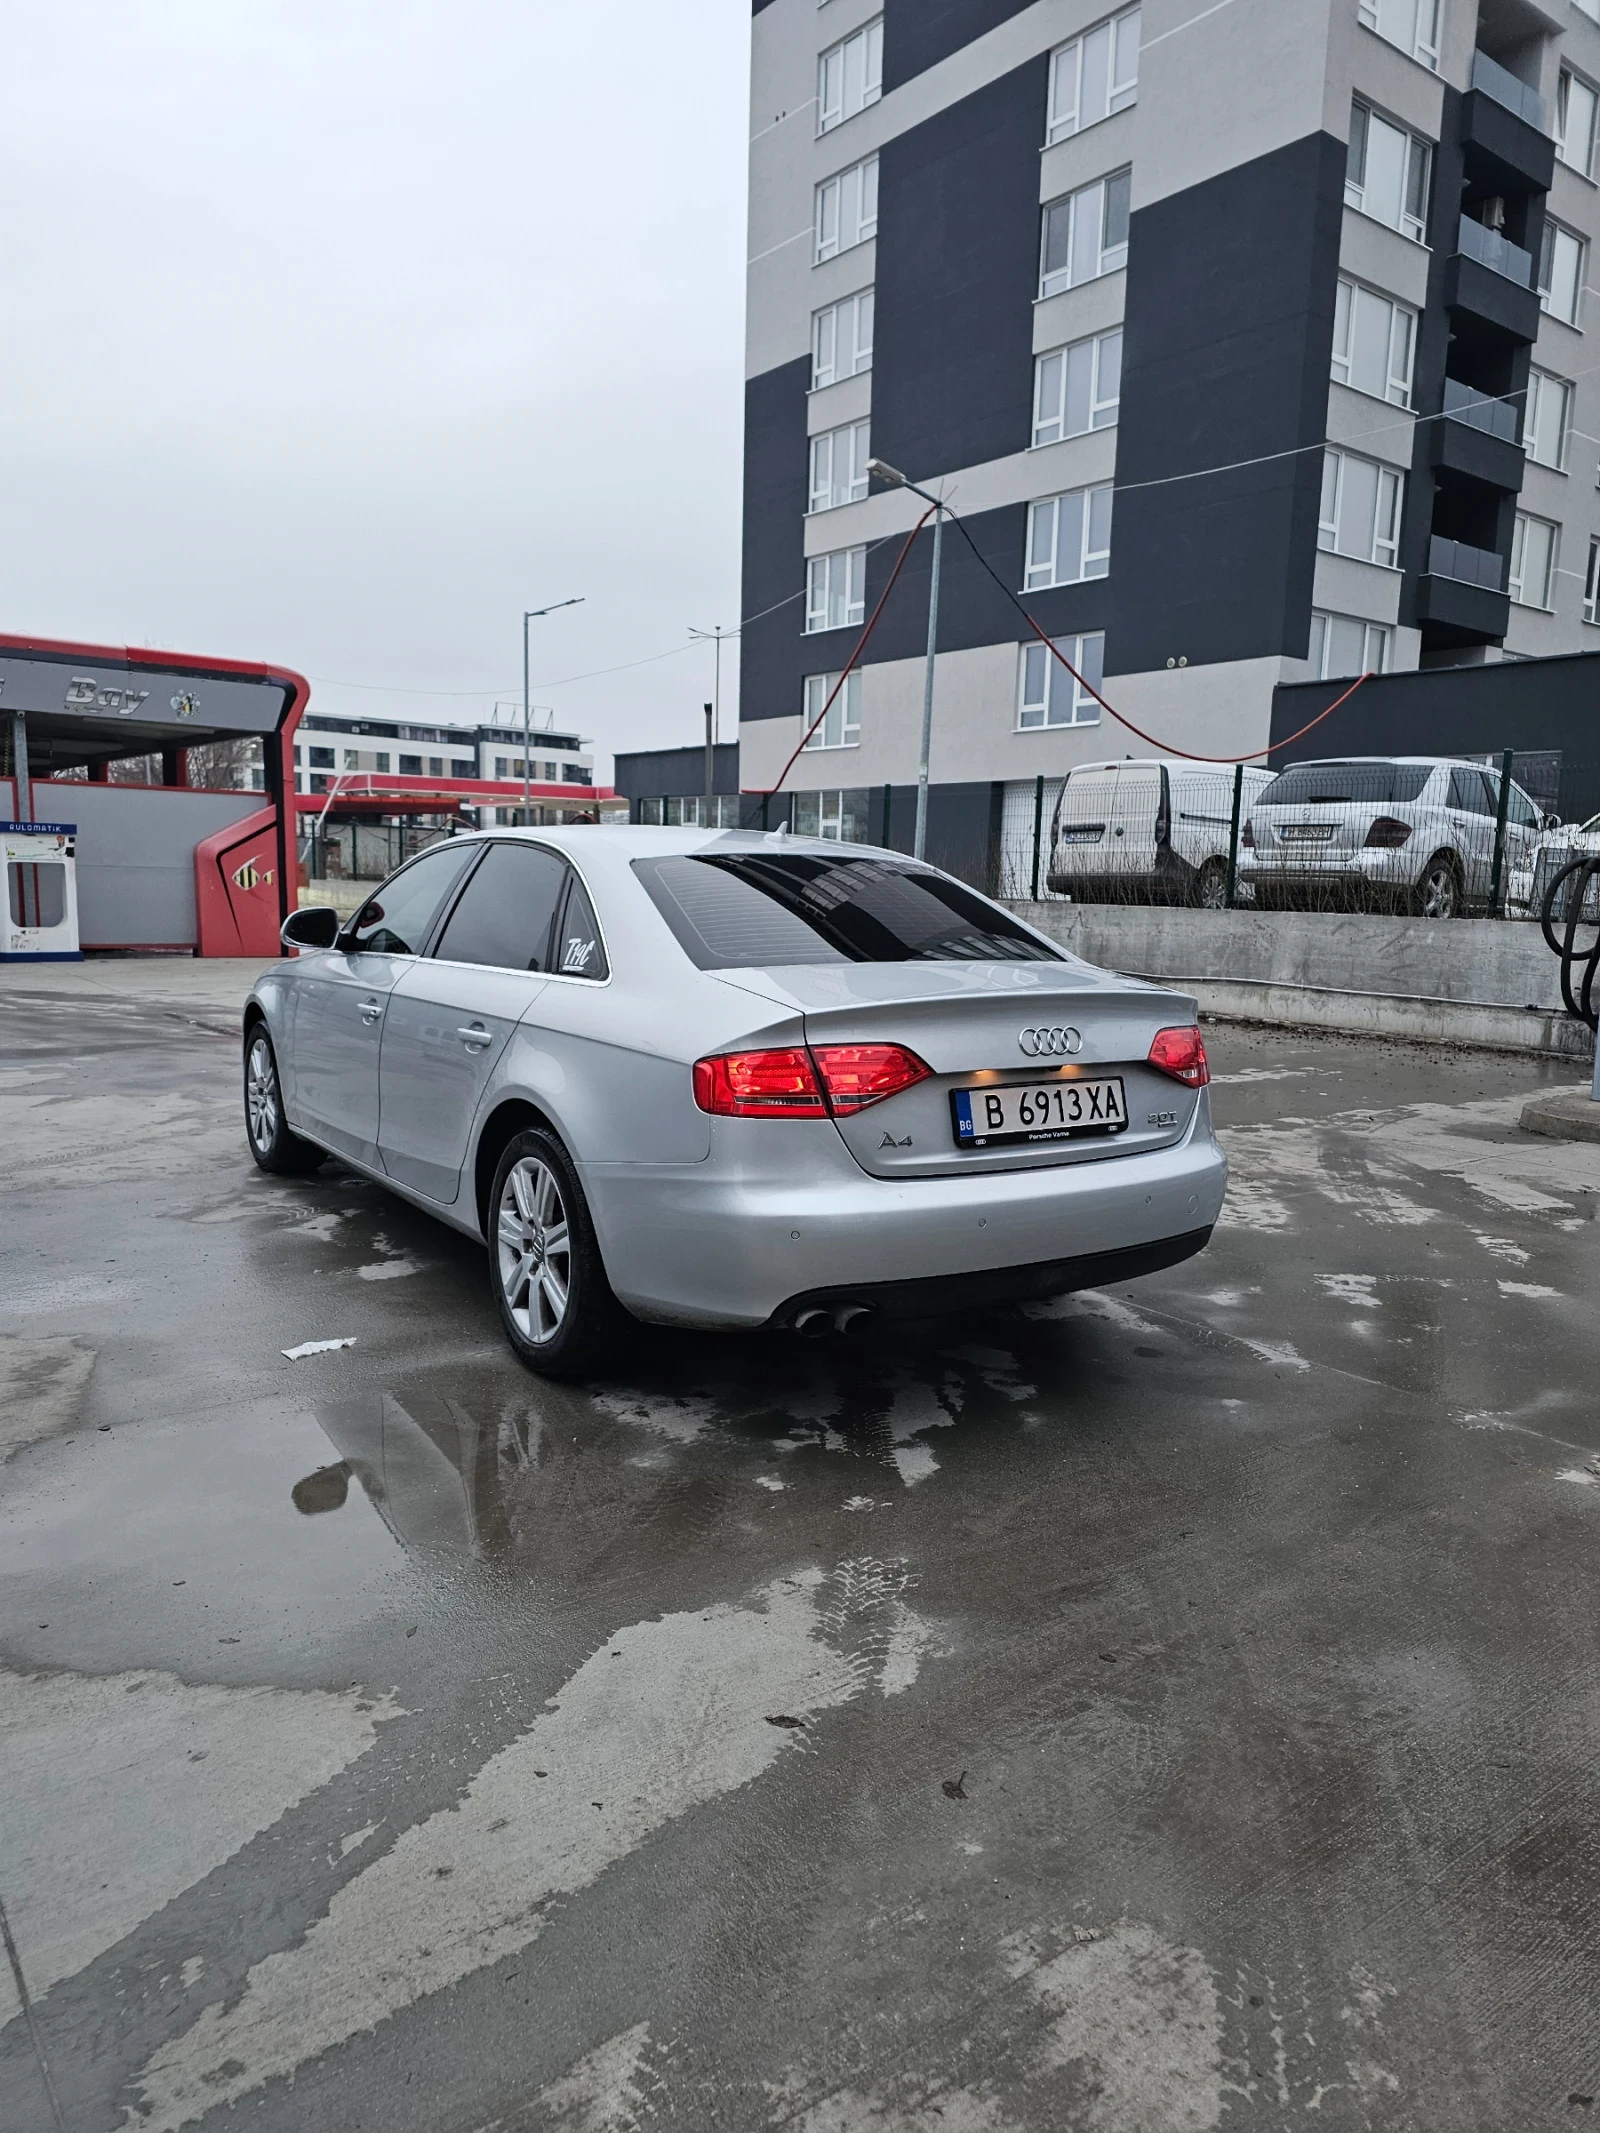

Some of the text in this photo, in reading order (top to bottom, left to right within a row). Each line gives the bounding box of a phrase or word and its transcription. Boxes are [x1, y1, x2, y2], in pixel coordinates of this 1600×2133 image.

[65, 676, 150, 715] Bay
[984, 1093, 1005, 1130] B
[959, 1119, 973, 1131] BG
[877, 1131, 913, 1149] A4
[1028, 1132, 1052, 1141] Porsche
